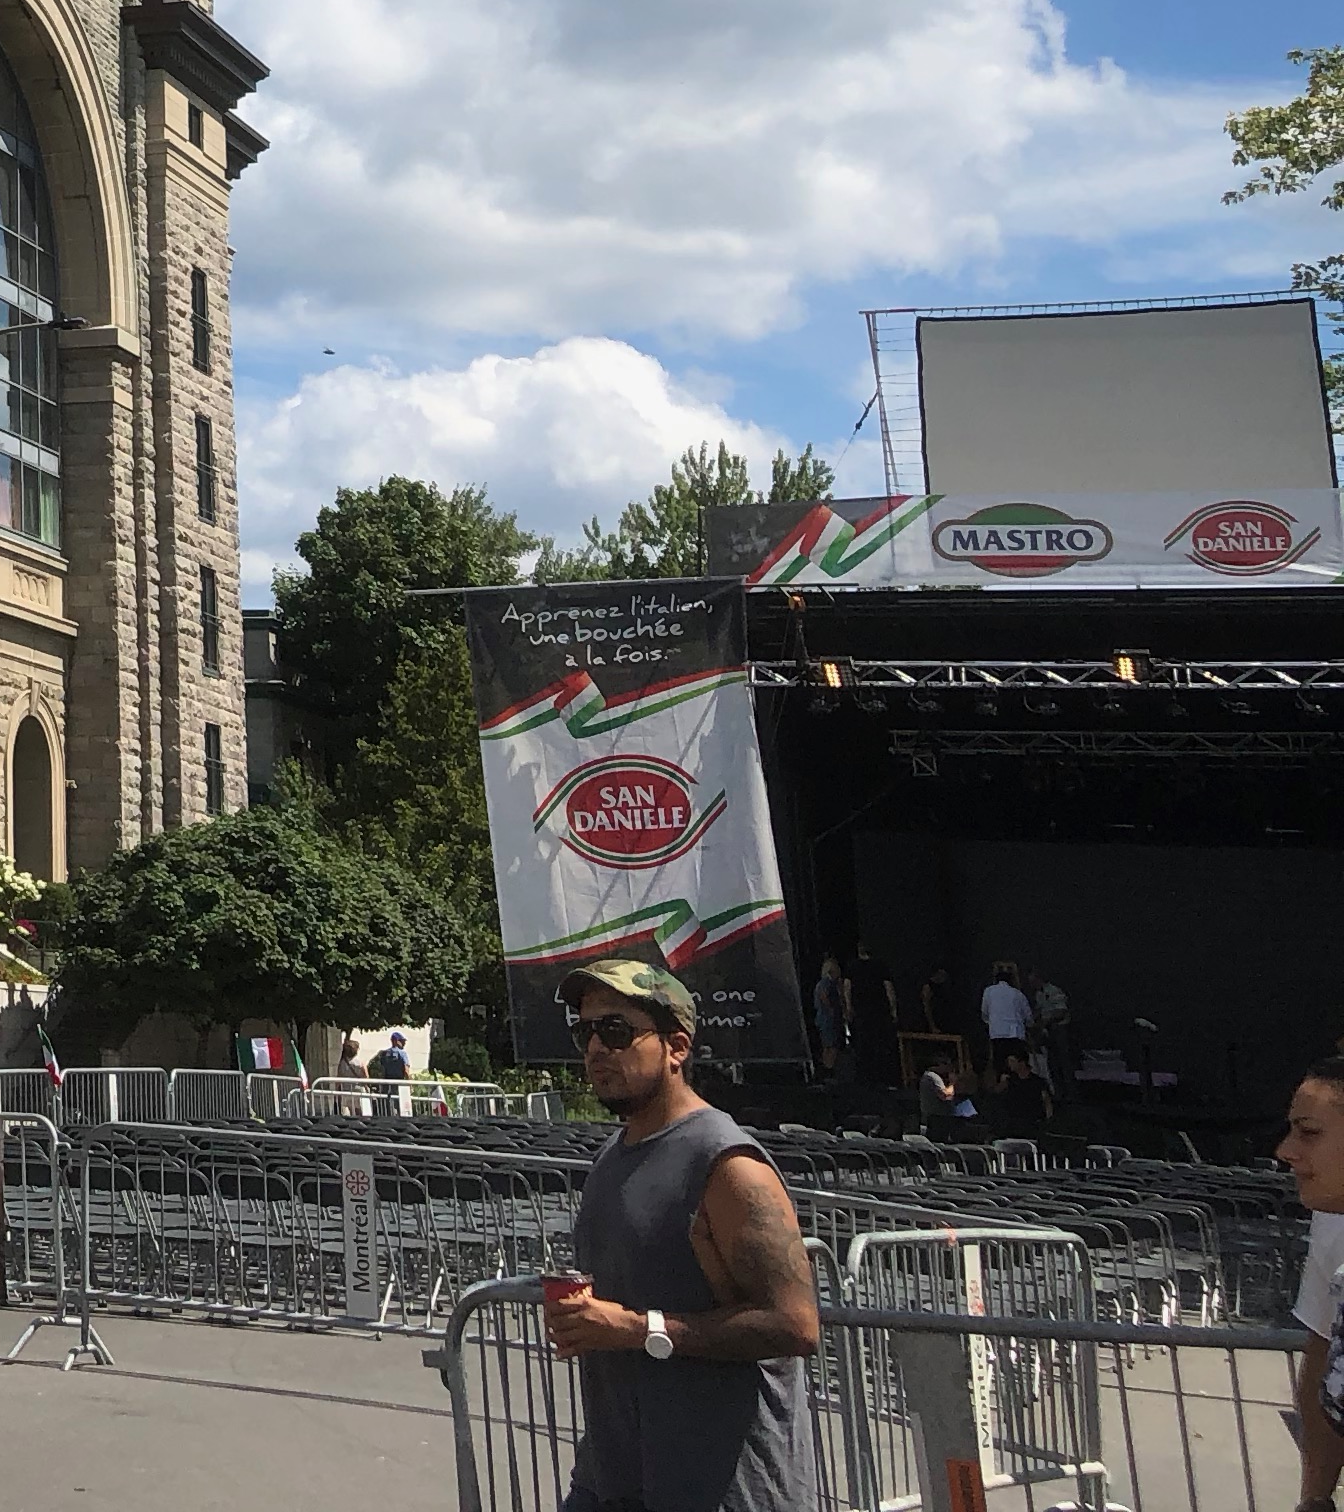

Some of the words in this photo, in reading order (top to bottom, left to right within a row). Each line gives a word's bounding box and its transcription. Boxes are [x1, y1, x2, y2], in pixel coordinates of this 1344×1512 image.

[951, 529, 1094, 552] MASTRO
[1218, 521, 1262, 536] SAN
[1197, 536, 1288, 552] DANIELE
[500, 602, 624, 633] Apprenez
[529, 634, 570, 646] une
[574, 617, 684, 643] bouchée
[586, 644, 607, 667] la
[612, 644, 669, 664] fois.
[599, 784, 656, 809] SAN
[573, 806, 687, 833] DANIELE
[711, 991, 757, 1003] one
[350, 1197, 371, 1293] Montréal
